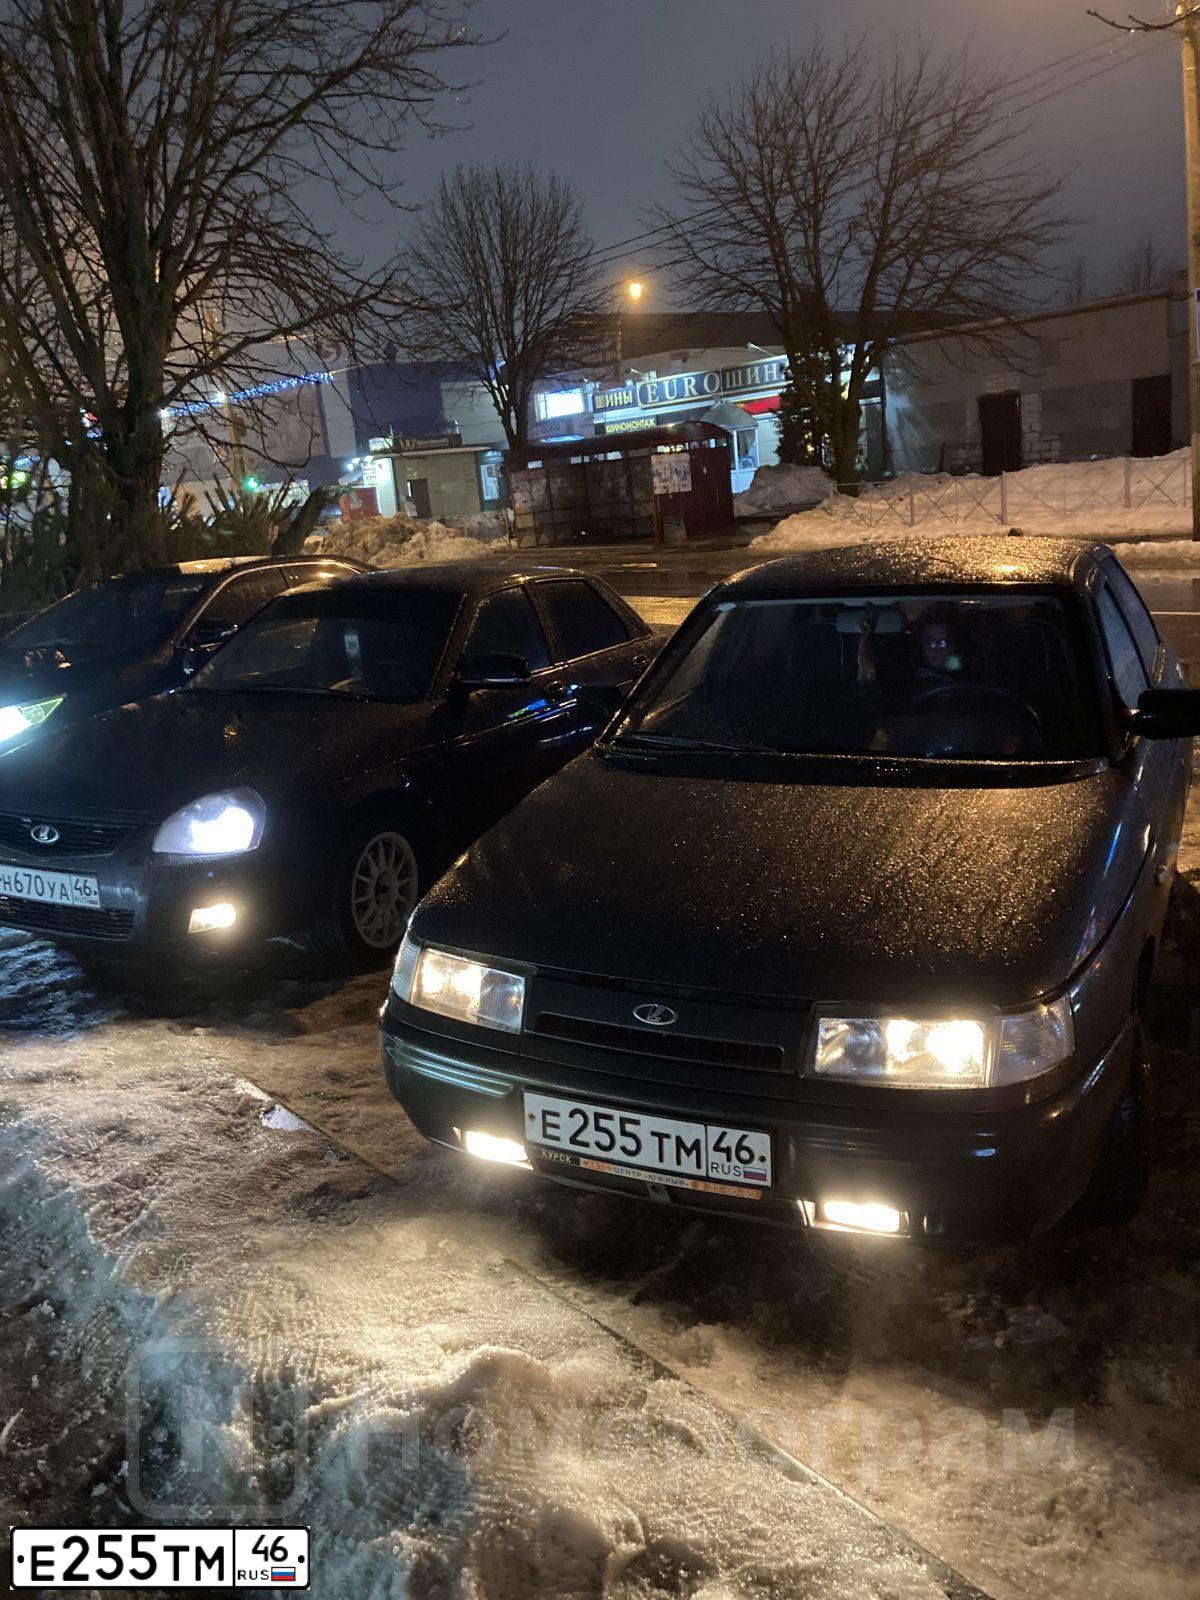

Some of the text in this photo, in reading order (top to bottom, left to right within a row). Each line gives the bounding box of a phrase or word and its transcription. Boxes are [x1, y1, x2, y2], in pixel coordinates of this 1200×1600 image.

[595, 389, 633, 409] ШИНЫ
[605, 417, 656, 433] ШИНОМОНТАЖ
[2, 872, 92, 901] Н670УА 46
[541, 1108, 756, 1169] Е255ТМ 46
[541, 1150, 572, 1164] КУРСК
[710, 1162, 742, 1177] RUS
